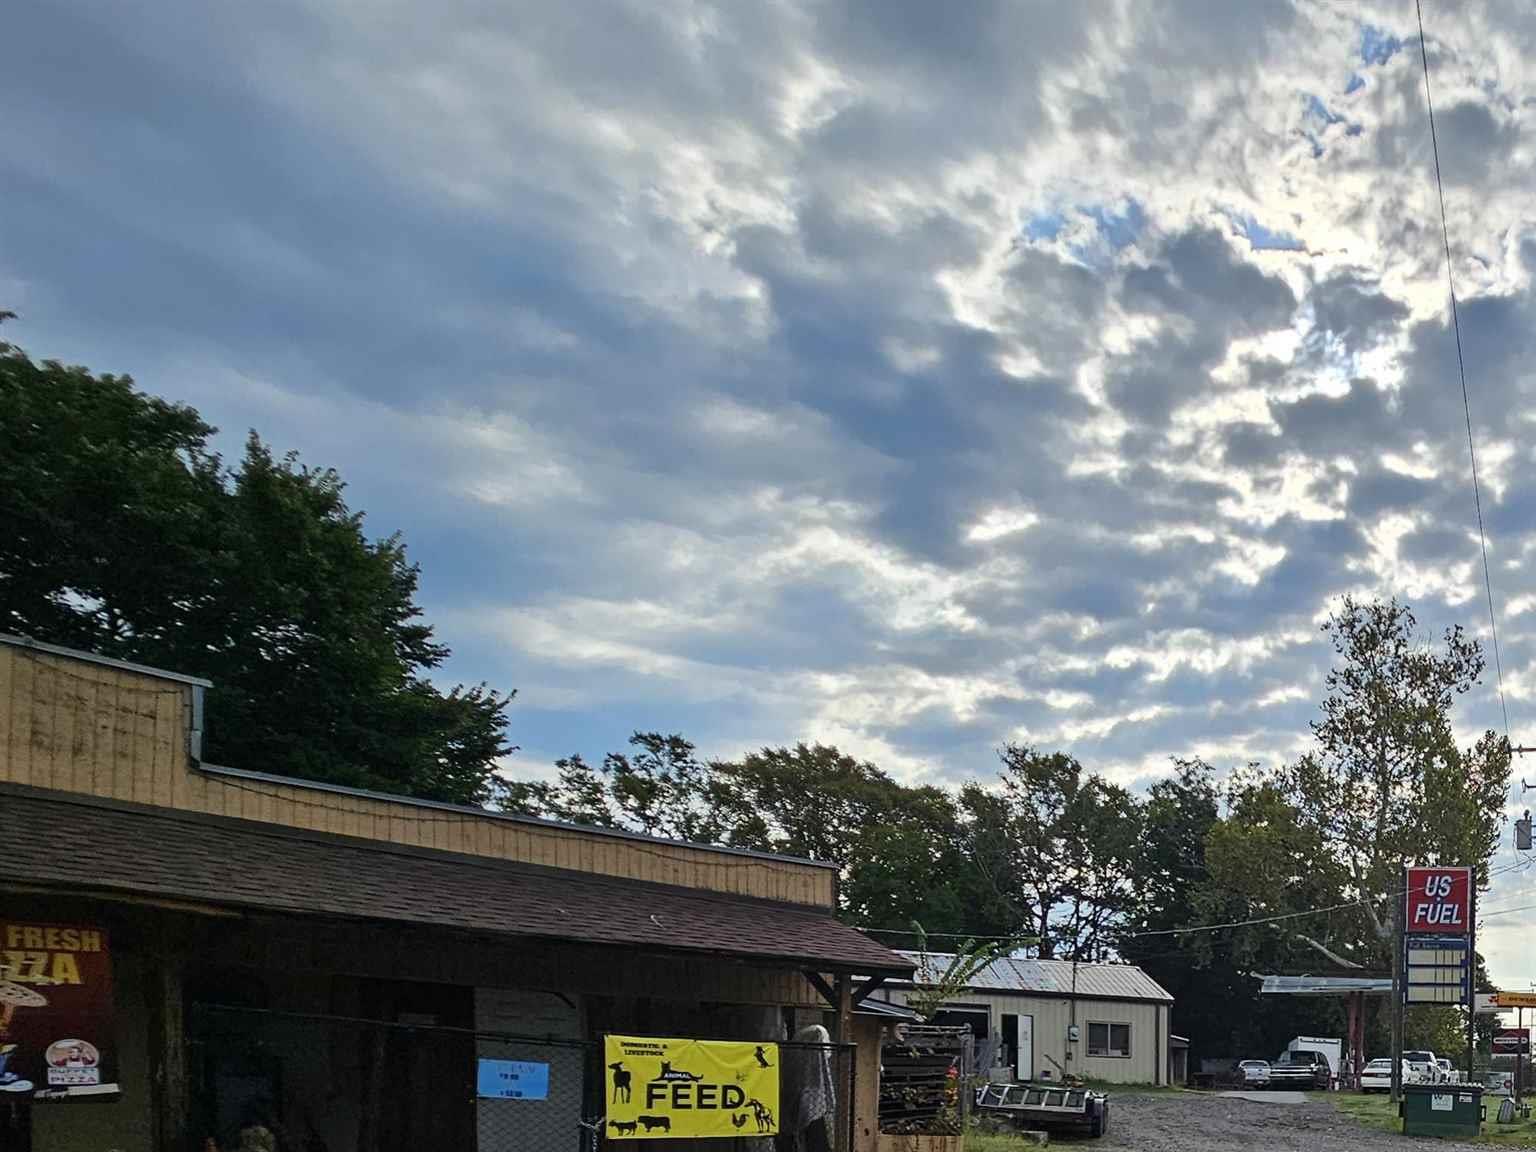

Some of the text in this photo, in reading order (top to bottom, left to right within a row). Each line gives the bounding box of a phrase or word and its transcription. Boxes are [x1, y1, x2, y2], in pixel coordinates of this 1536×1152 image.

[1425, 875, 1452, 897] US
[1414, 903, 1462, 924] FUEL
[7, 924, 102, 952] FRESH
[646, 1083, 746, 1110] FEED
